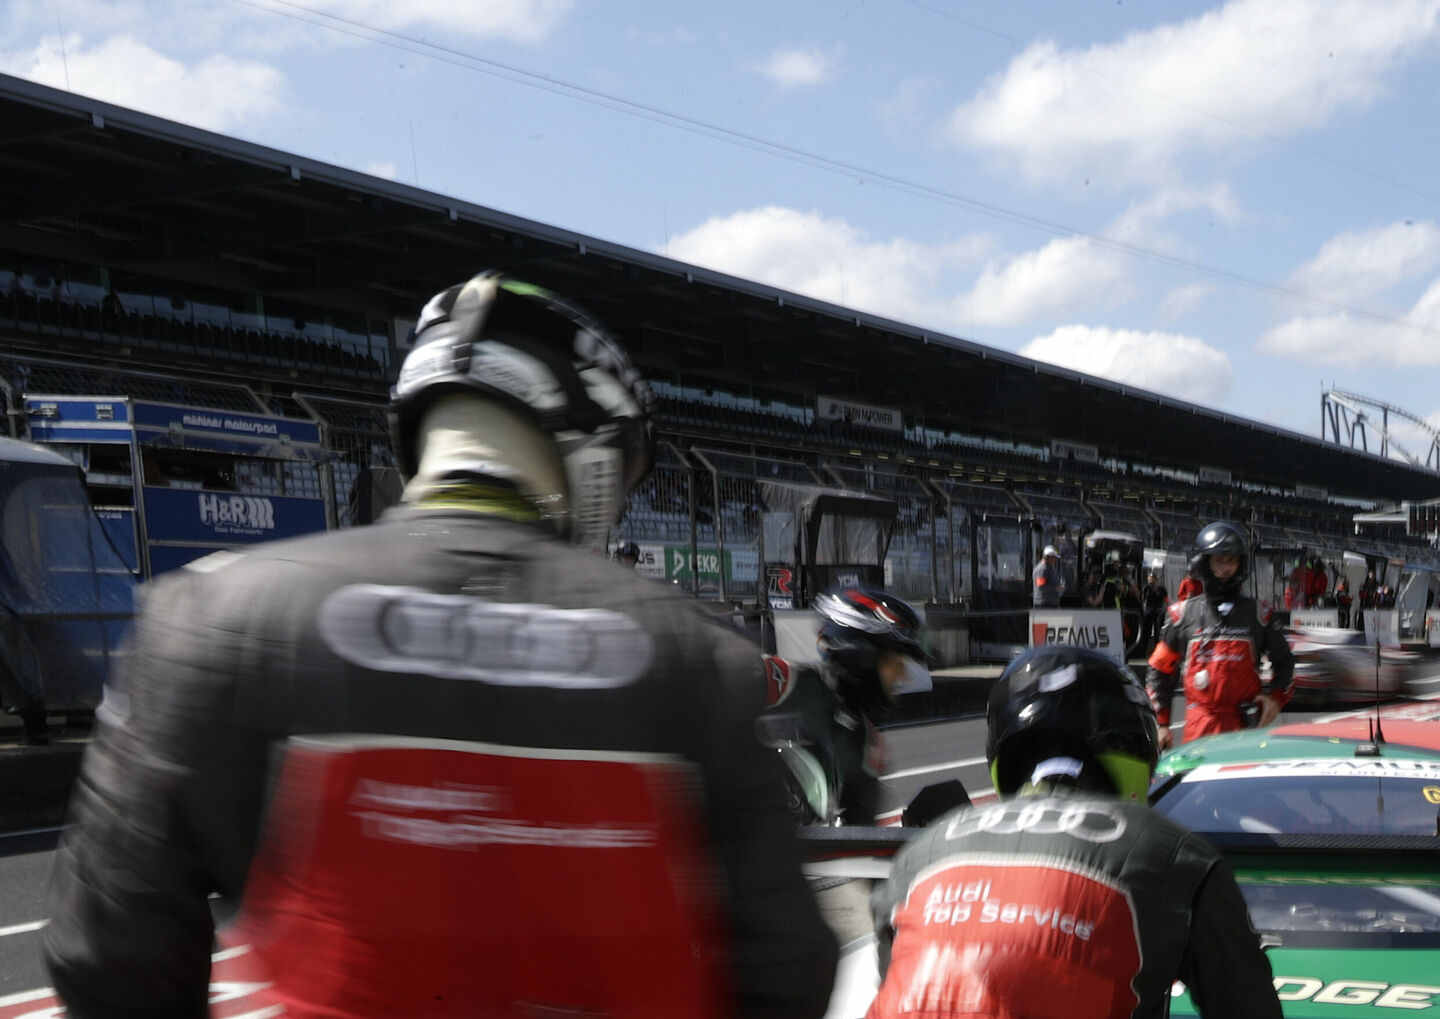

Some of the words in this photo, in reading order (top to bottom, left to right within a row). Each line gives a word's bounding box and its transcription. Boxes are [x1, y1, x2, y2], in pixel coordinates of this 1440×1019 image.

[224, 420, 278, 434] motorsport
[199, 494, 248, 525] H&R
[1046, 626, 1111, 649] REMUS
[925, 879, 992, 904] Audi
[923, 901, 972, 926] Top
[980, 899, 1094, 941] Service
